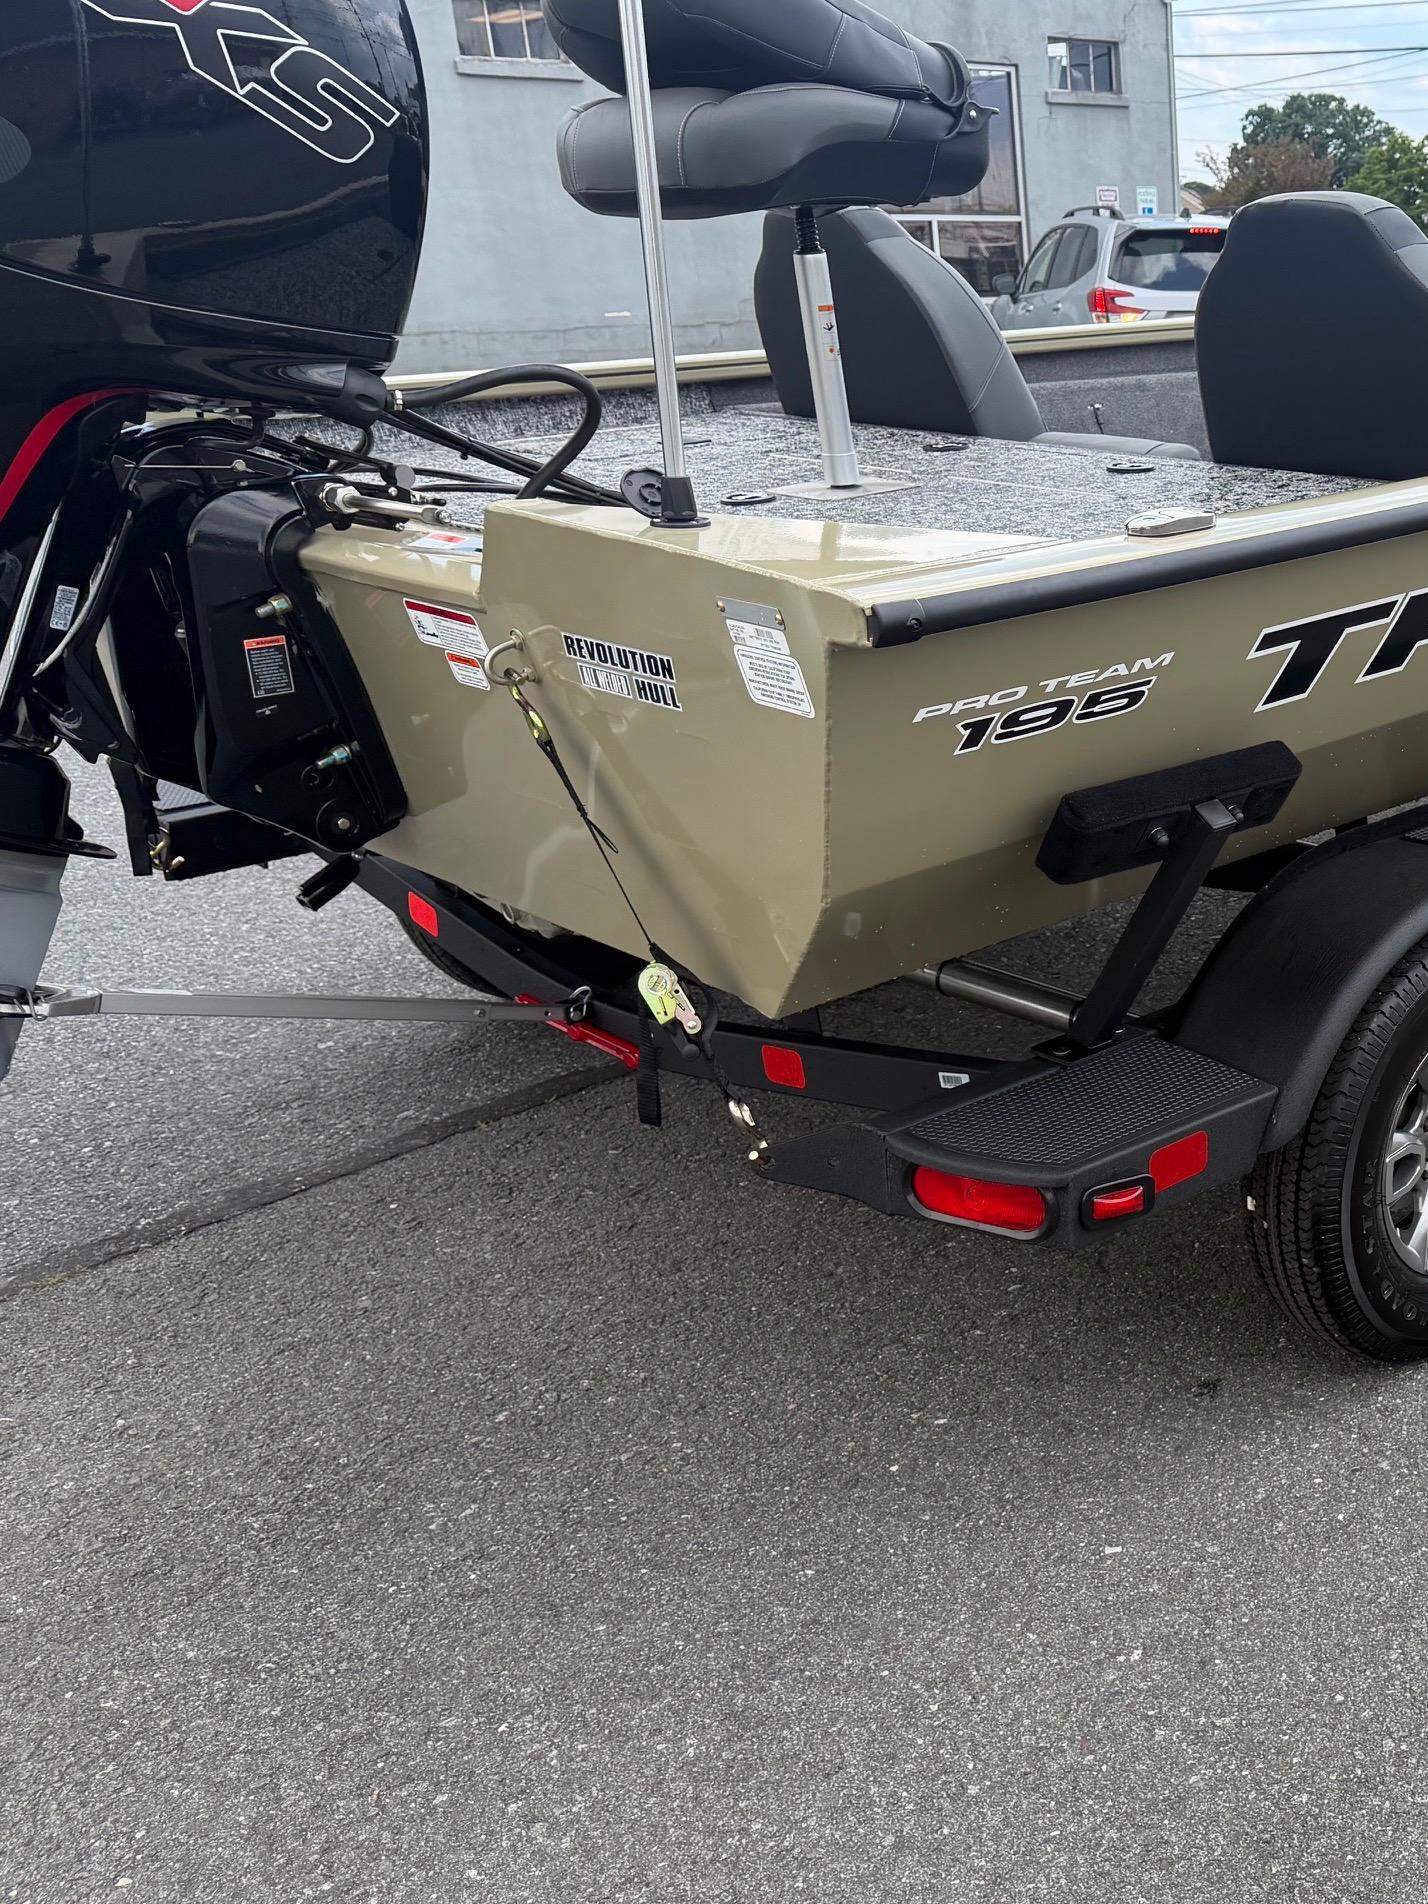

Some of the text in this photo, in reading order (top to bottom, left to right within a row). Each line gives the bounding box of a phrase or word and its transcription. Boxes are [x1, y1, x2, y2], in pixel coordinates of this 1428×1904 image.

[562, 634, 676, 681] REVOLUTION
[583, 666, 629, 696] ALL WELDED
[634, 678, 682, 709] HULL
[912, 651, 1176, 724] PRO TEAM
[953, 675, 1159, 756] 195
